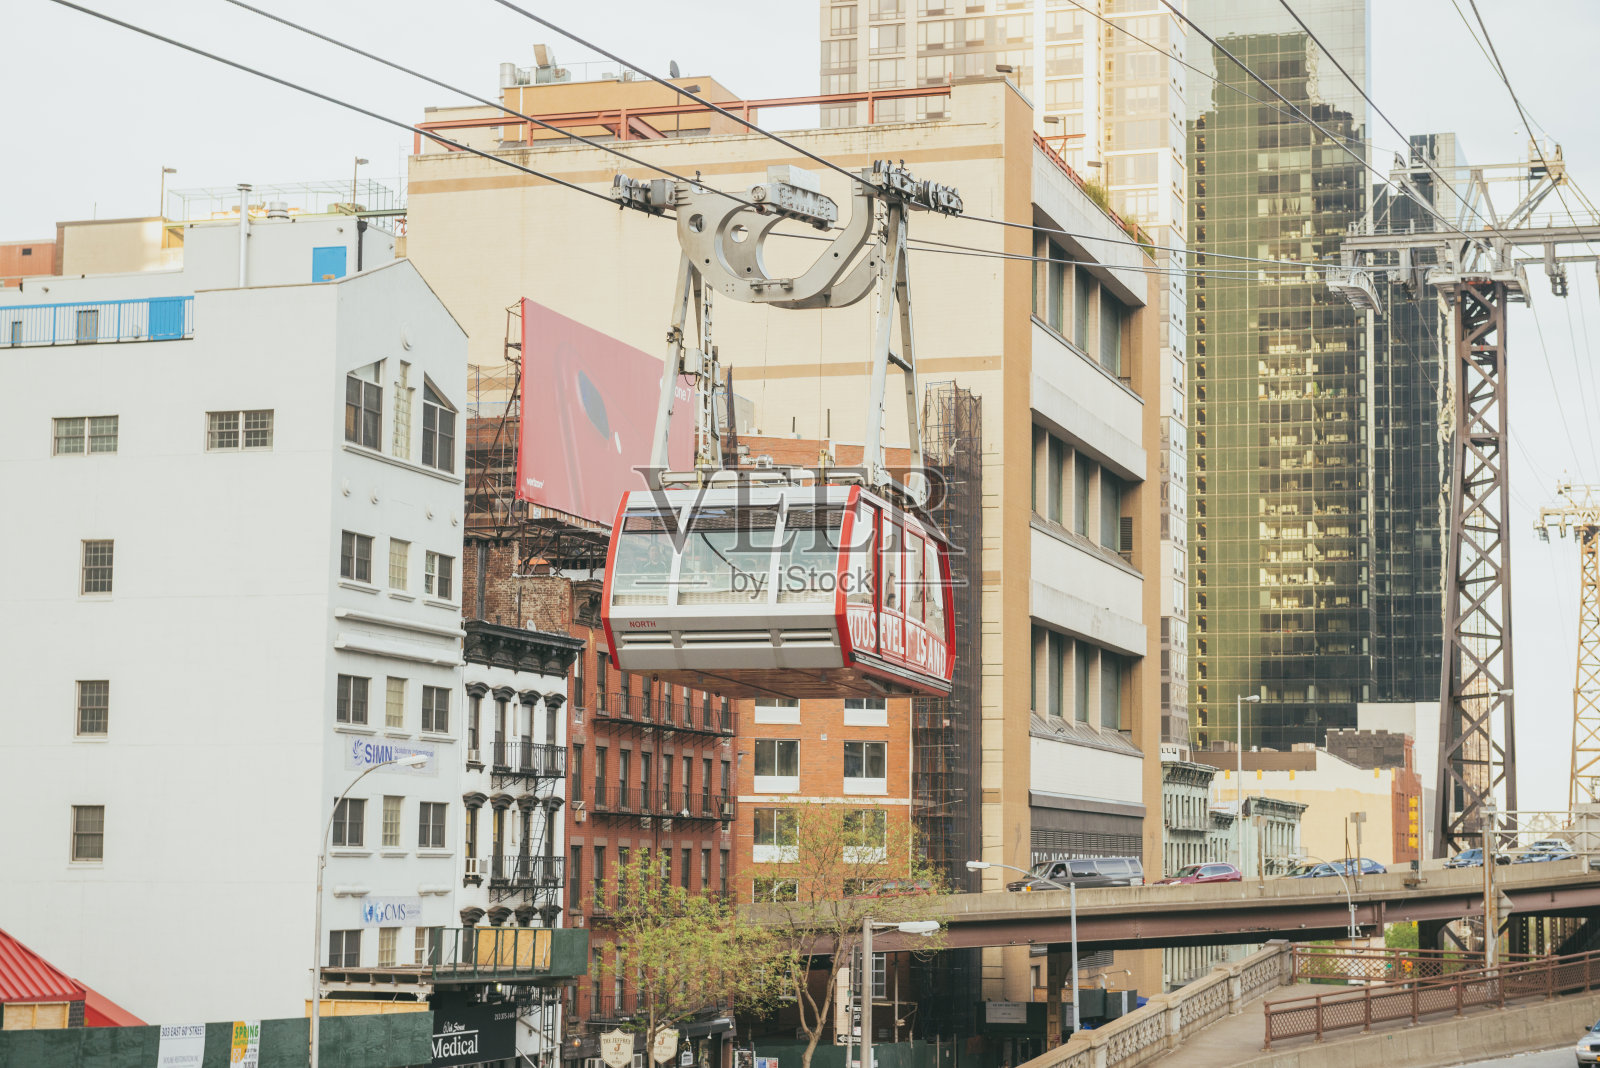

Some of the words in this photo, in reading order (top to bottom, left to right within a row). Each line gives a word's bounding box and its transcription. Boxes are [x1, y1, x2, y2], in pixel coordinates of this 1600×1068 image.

[629, 620, 656, 628] NORTH
[365, 743, 392, 763] SIMN
[385, 903, 406, 920] CMS
[170, 1026, 182, 1036] EAST
[235, 1025, 259, 1039] SPRING
